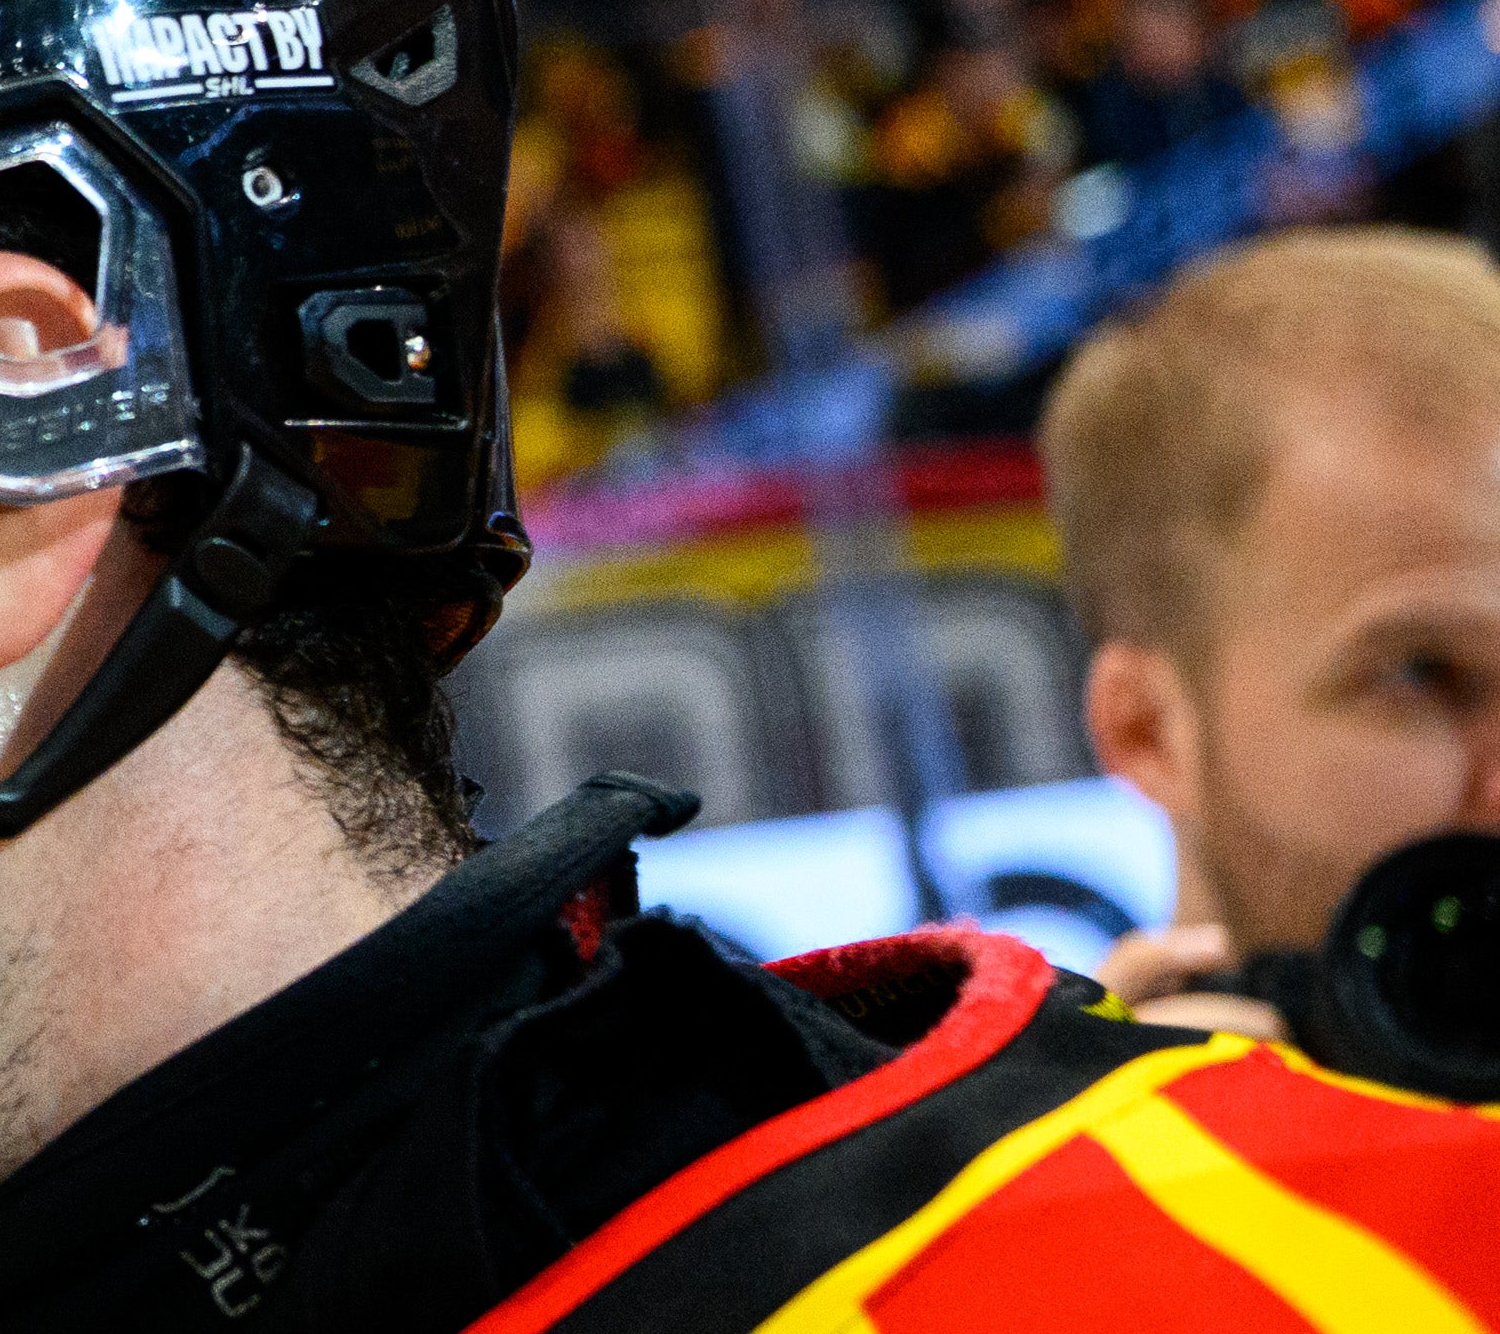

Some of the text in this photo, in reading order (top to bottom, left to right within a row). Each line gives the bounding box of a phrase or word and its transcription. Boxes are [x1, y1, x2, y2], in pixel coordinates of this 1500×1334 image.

[91, 8, 323, 86] IMPACT BY
[205, 75, 255, 99] SHL
